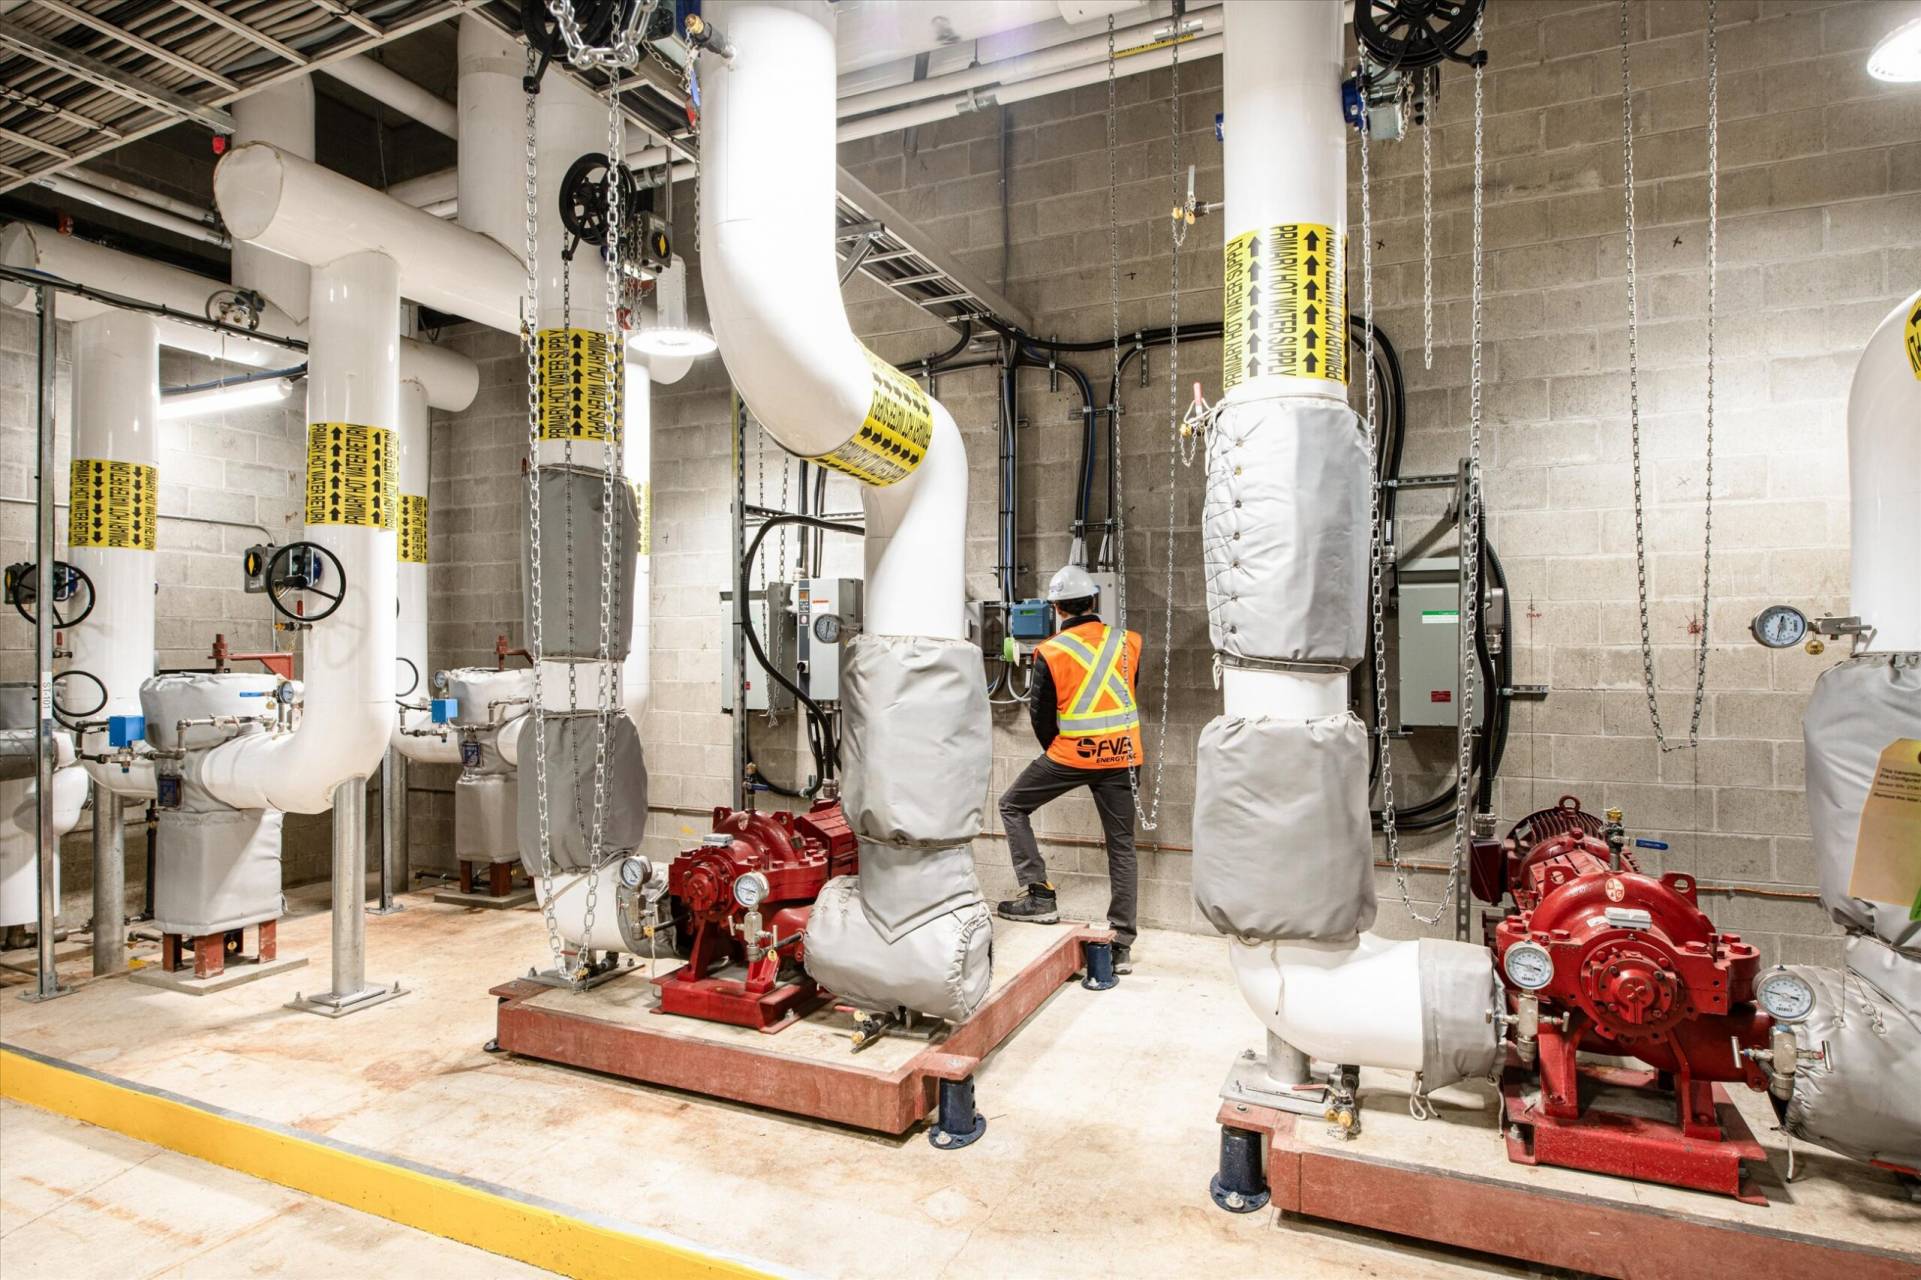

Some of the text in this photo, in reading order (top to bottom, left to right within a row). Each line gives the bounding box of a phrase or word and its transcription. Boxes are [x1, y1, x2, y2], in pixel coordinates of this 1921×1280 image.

[1224, 239, 1244, 388] PRIMARY HOT WATER SUPPLY
[1268, 225, 1297, 377] PRIMARY HOT WATER SUPPLY
[1325, 271, 1343, 309] WATER
[1325, 308, 1343, 334] HOT
[548, 329, 566, 439] PRIMARY HOT WATER SUPPLY
[588, 331, 607, 440] PRIMARY HOT WATER SUPPLY
[1325, 333, 1343, 381] PRIMARY
[73, 460, 89, 546] PRIMARY HOT WATER RETURN
[109, 462, 130, 547] PRIMARY HOT WATER RETURN
[144, 466, 156, 550] PRIMARY HOT WATER RETURN
[311, 424, 327, 524] PRIMARY HOT WATER RETURN
[345, 424, 368, 525] PRIMARY HOT WATER RETURN
[413, 496, 423, 562] PRIMARY HOT WATER RETURN
[42, 682, 51, 709] ST-101
[1096, 755, 1125, 764] ENERGY
